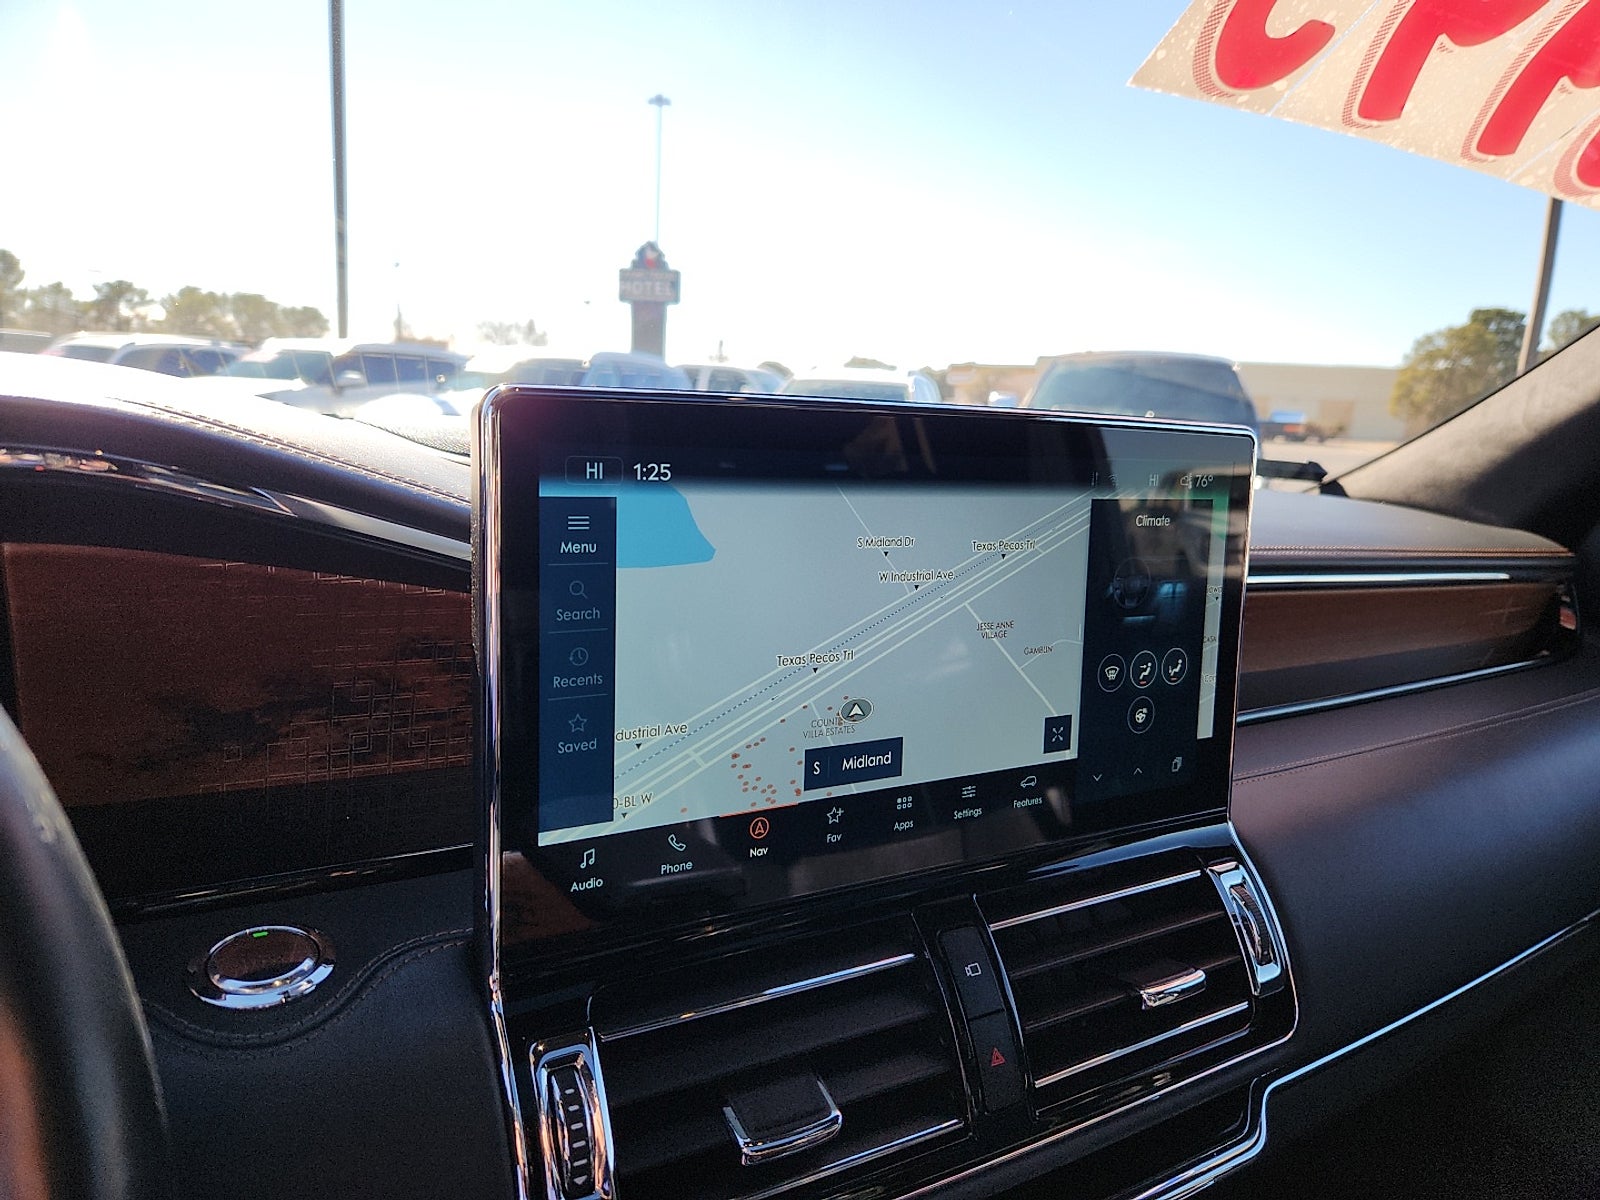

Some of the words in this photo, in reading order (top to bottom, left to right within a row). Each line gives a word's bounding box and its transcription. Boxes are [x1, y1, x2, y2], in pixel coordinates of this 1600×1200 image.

[586, 462, 603, 479] HI
[633, 463, 671, 481] 1:25
[1149, 475, 1159, 486] HI
[1135, 514, 1171, 527] Climate
[560, 541, 597, 554] Menu
[857, 538, 863, 548] S
[865, 536, 902, 548] Midland
[904, 536, 915, 546] Dr
[972, 541, 997, 551] Texas
[998, 540, 1023, 550] Pecos
[1025, 540, 1036, 549] Trl
[879, 572, 889, 582] W
[891, 570, 934, 582] Industrial
[936, 570, 954, 580] Ave
[556, 607, 601, 621] Search
[977, 621, 994, 632] JESSE
[995, 620, 1015, 630] ANNE
[981, 630, 1008, 640] VILLAGE
[776, 654, 808, 667] Texas
[809, 651, 838, 665] Pecos
[839, 650, 855, 662] Trl
[553, 673, 603, 688] Recents
[664, 722, 688, 735] Ave
[803, 729, 824, 739] VILLA
[825, 724, 856, 737] ESTATES
[558, 738, 597, 754] Saved
[842, 751, 892, 771] Midland
[813, 762, 821, 775] S
[641, 792, 653, 804] W
[1013, 796, 1043, 808] Features
[954, 806, 982, 820] Settings
[893, 819, 914, 832] Apps
[826, 831, 842, 844] Fav
[750, 846, 768, 858] Nav
[660, 860, 693, 875] Phone
[570, 877, 604, 893] Audio
